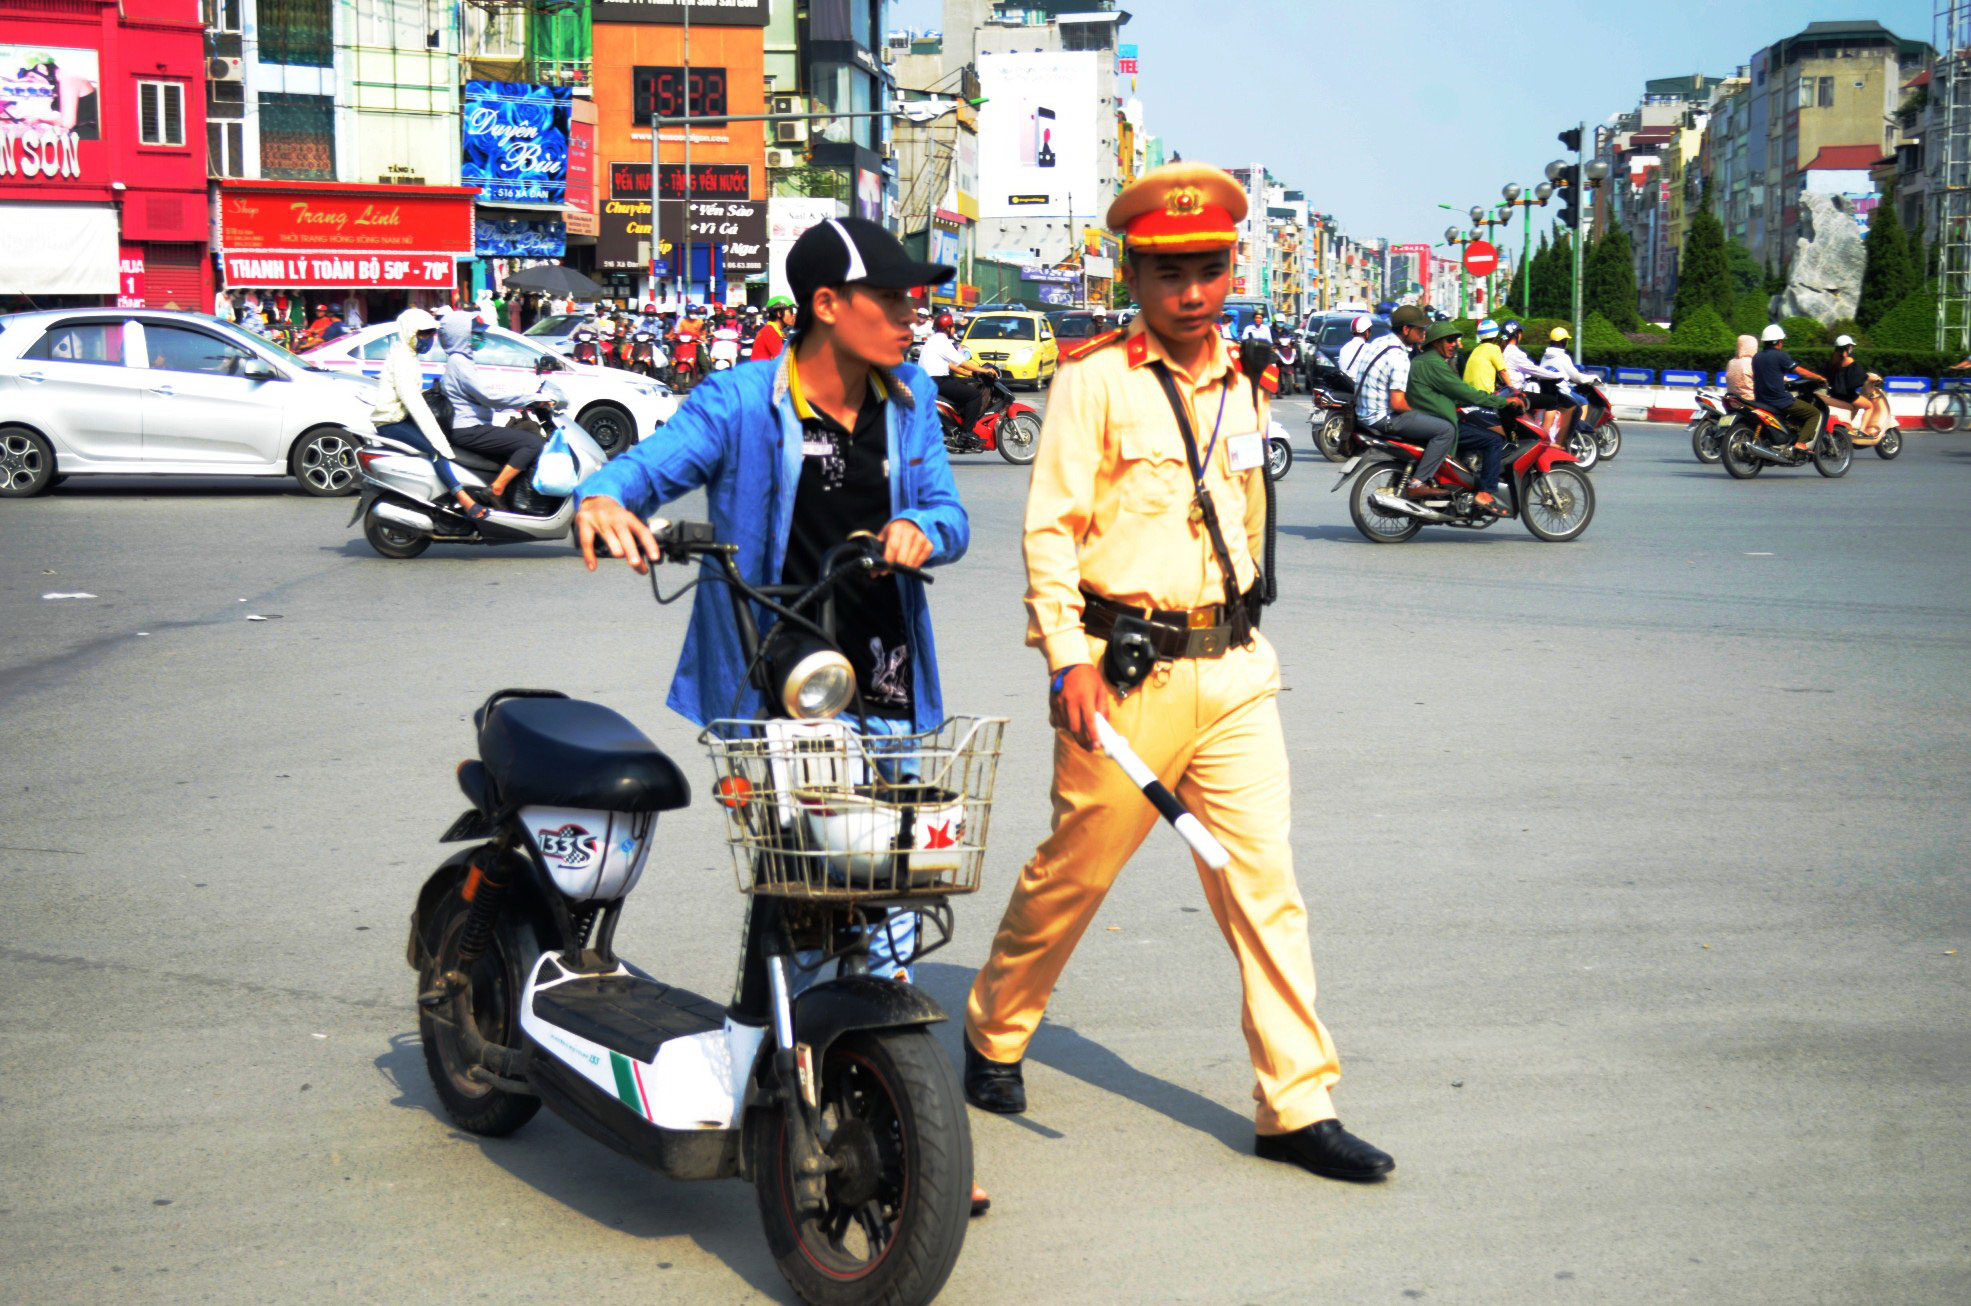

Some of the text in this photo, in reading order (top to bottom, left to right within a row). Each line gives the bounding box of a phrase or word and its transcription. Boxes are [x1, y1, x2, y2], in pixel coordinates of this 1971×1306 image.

[650, 75, 723, 116] 15:22
[468, 107, 540, 146] Duyên
[500, 141, 567, 173] Bùi
[291, 202, 400, 231] Trang Linh
[229, 259, 285, 279] THANH
[289, 256, 308, 280] LÝ
[311, 257, 355, 280] TOÀN
[358, 257, 380, 284] BỘ
[126, 277, 135, 294] 1
